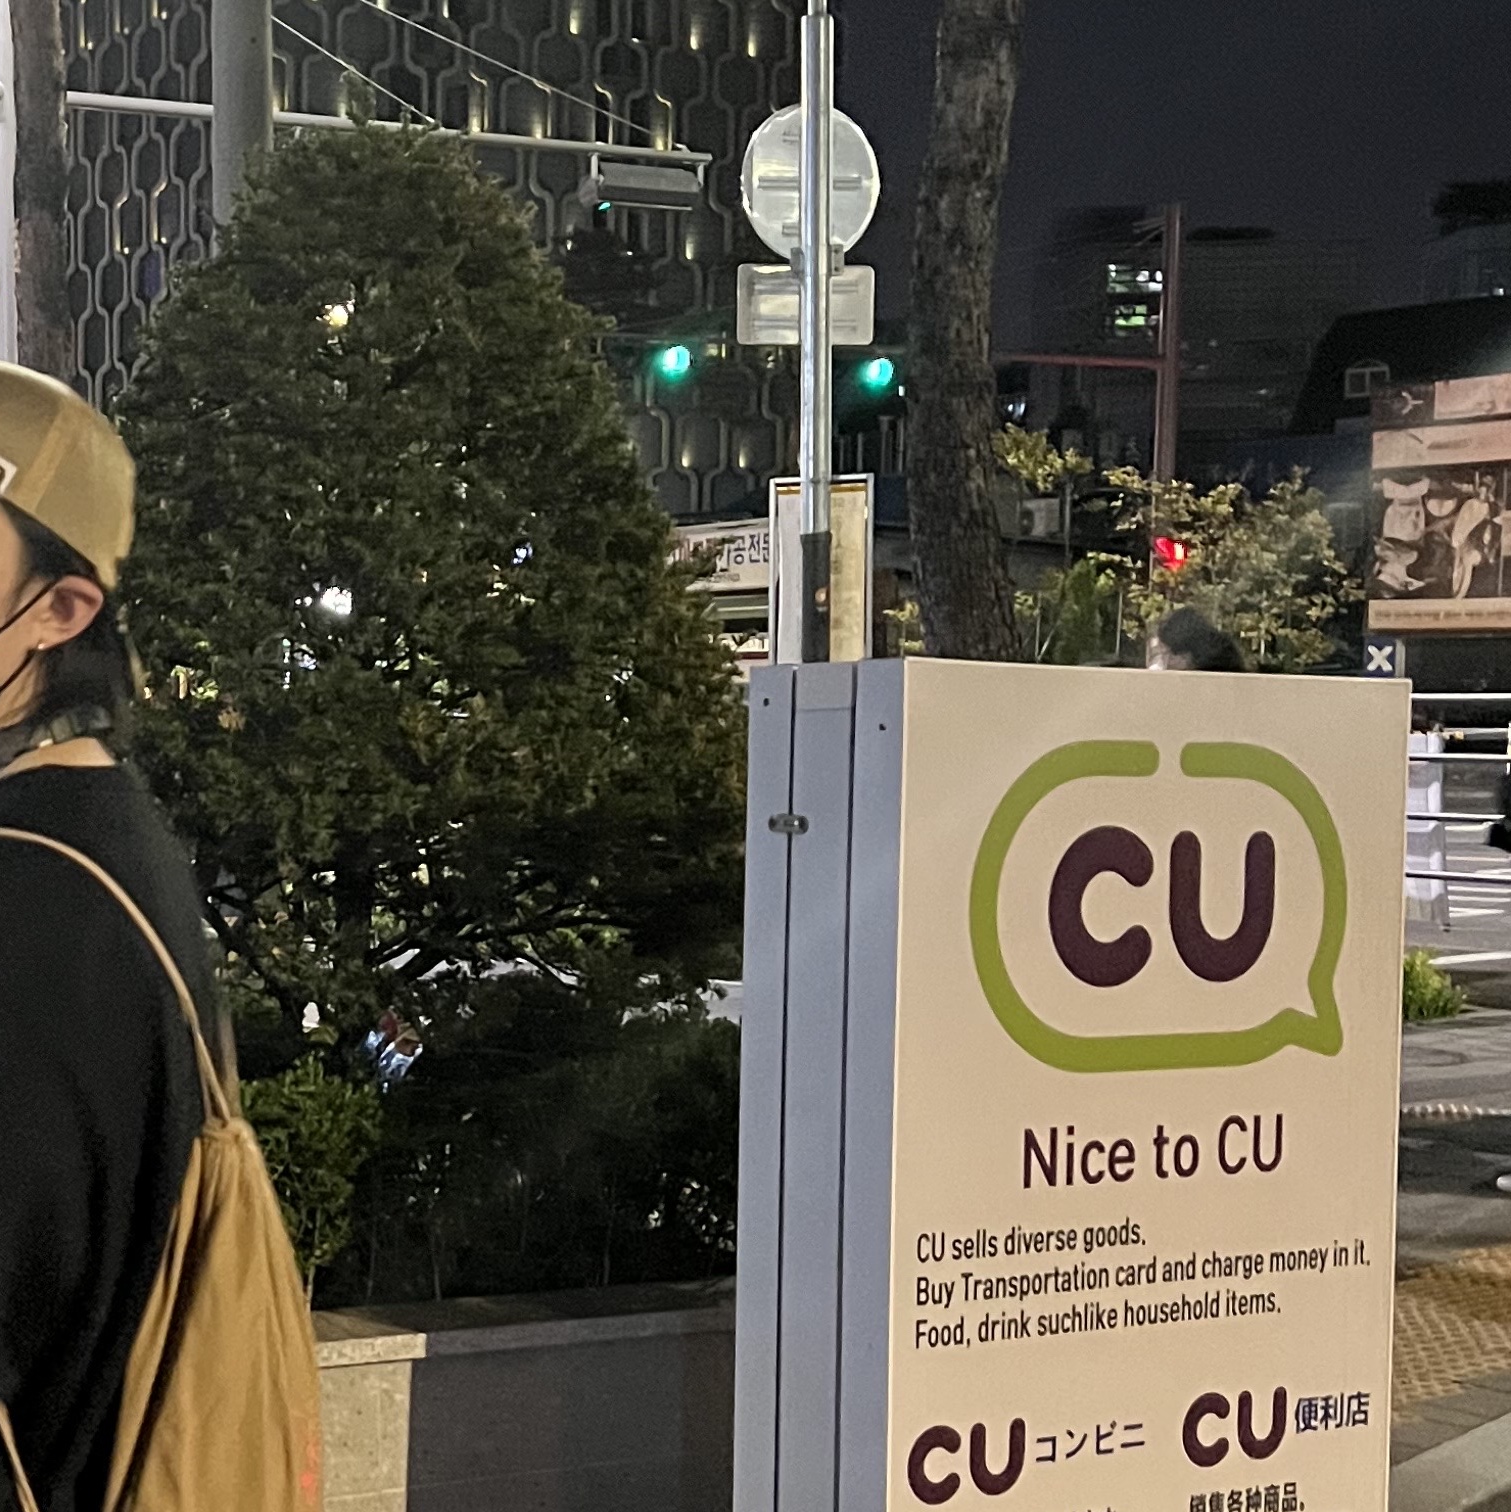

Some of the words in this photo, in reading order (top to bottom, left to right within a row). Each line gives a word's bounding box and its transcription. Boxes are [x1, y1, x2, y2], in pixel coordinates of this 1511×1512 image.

[1048, 824, 1276, 988] CU
[1022, 1124, 1136, 1189] Nice
[1153, 1124, 1200, 1179] to
[1217, 1113, 1284, 1176] CU
[916, 1276, 955, 1309] Buy
[960, 1261, 1110, 1302] Transportation
[1115, 1255, 1157, 1287] card
[1162, 1251, 1197, 1283] and
[1201, 1250, 1265, 1280] charge
[1269, 1246, 1330, 1274] money
[1333, 1239, 1349, 1267] in
[1353, 1237, 1371, 1266] it.
[917, 1231, 946, 1264] CU
[951, 1228, 999, 1260] sells
[1003, 1224, 1078, 1256] diverse
[1083, 1216, 1146, 1254] goods.
[915, 1315, 971, 1350] Food,
[978, 1308, 1032, 1343] drink
[1037, 1300, 1119, 1337] suchlike
[1123, 1290, 1220, 1328] household
[1225, 1288, 1282, 1317] items.
[907, 1417, 1026, 1505] CU
[1035, 1420, 1146, 1463] コンビニ
[1182, 1386, 1288, 1468] CU
[1294, 1391, 1370, 1434] 便利店
